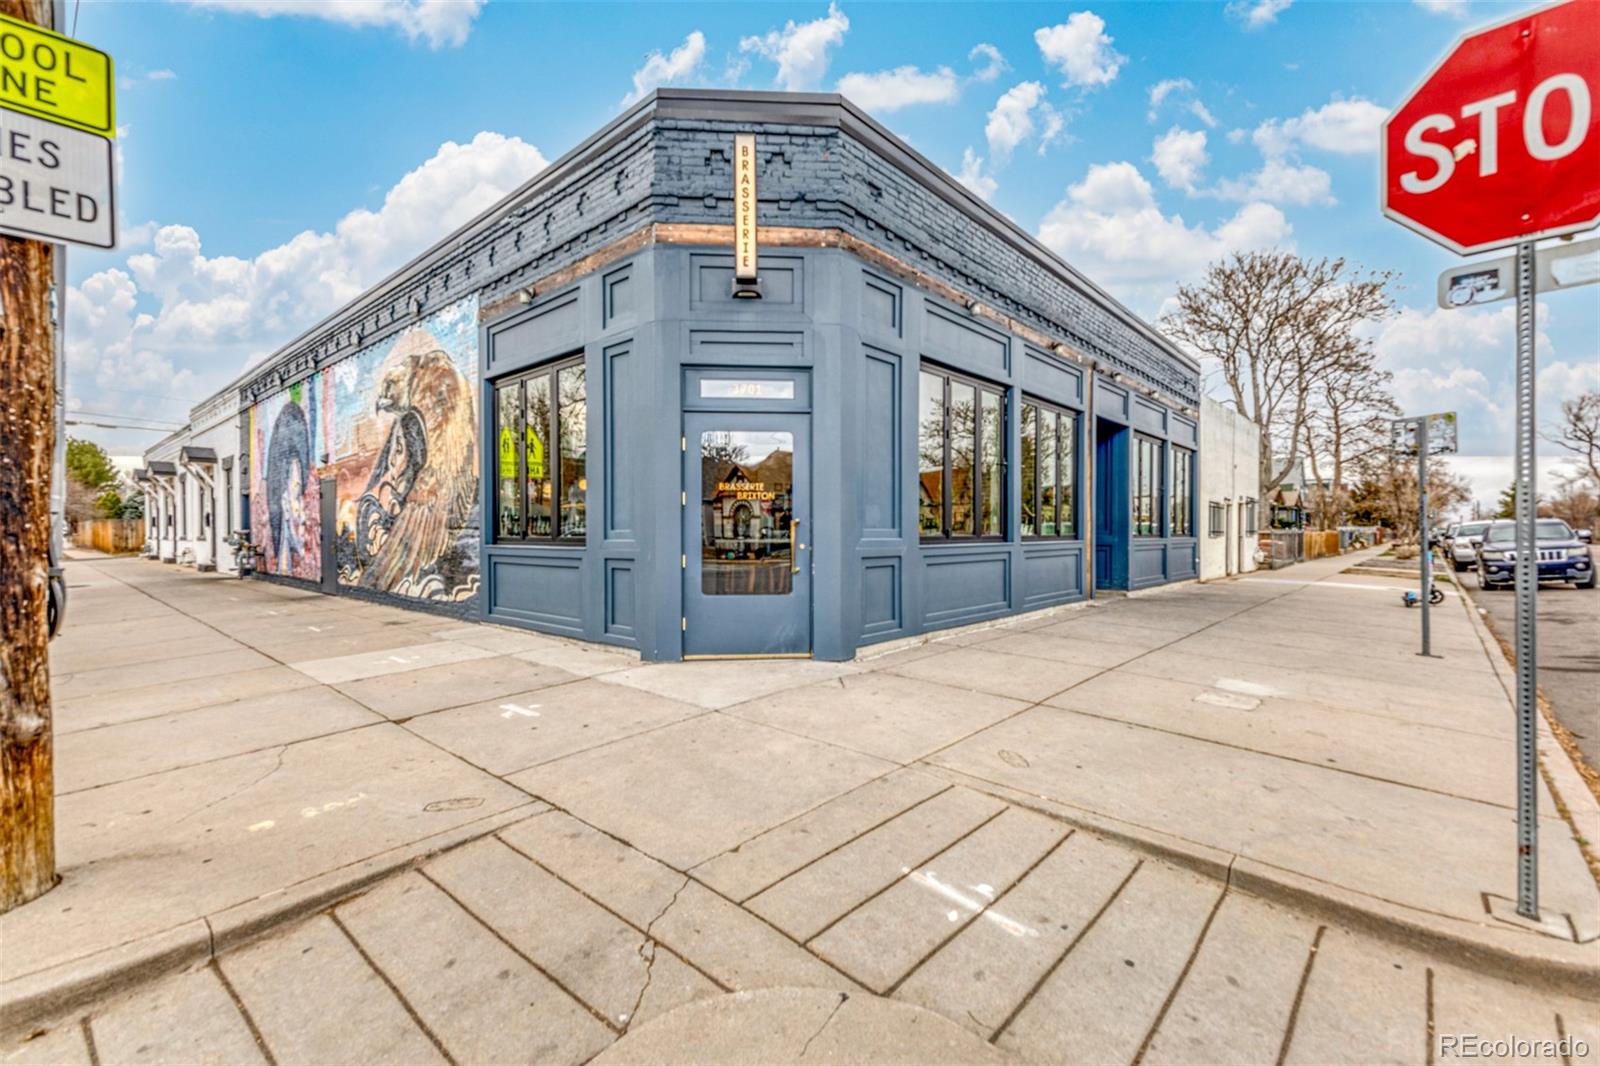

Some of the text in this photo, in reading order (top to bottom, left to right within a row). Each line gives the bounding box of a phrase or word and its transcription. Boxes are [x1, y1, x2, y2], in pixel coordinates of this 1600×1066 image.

[0, 127, 61, 170] ES
[1400, 72, 1592, 195] STO
[741, 146, 751, 268] BRASSERIE
[718, 482, 764, 491] BRASSERIE
[737, 491, 775, 501] BRIXTON
